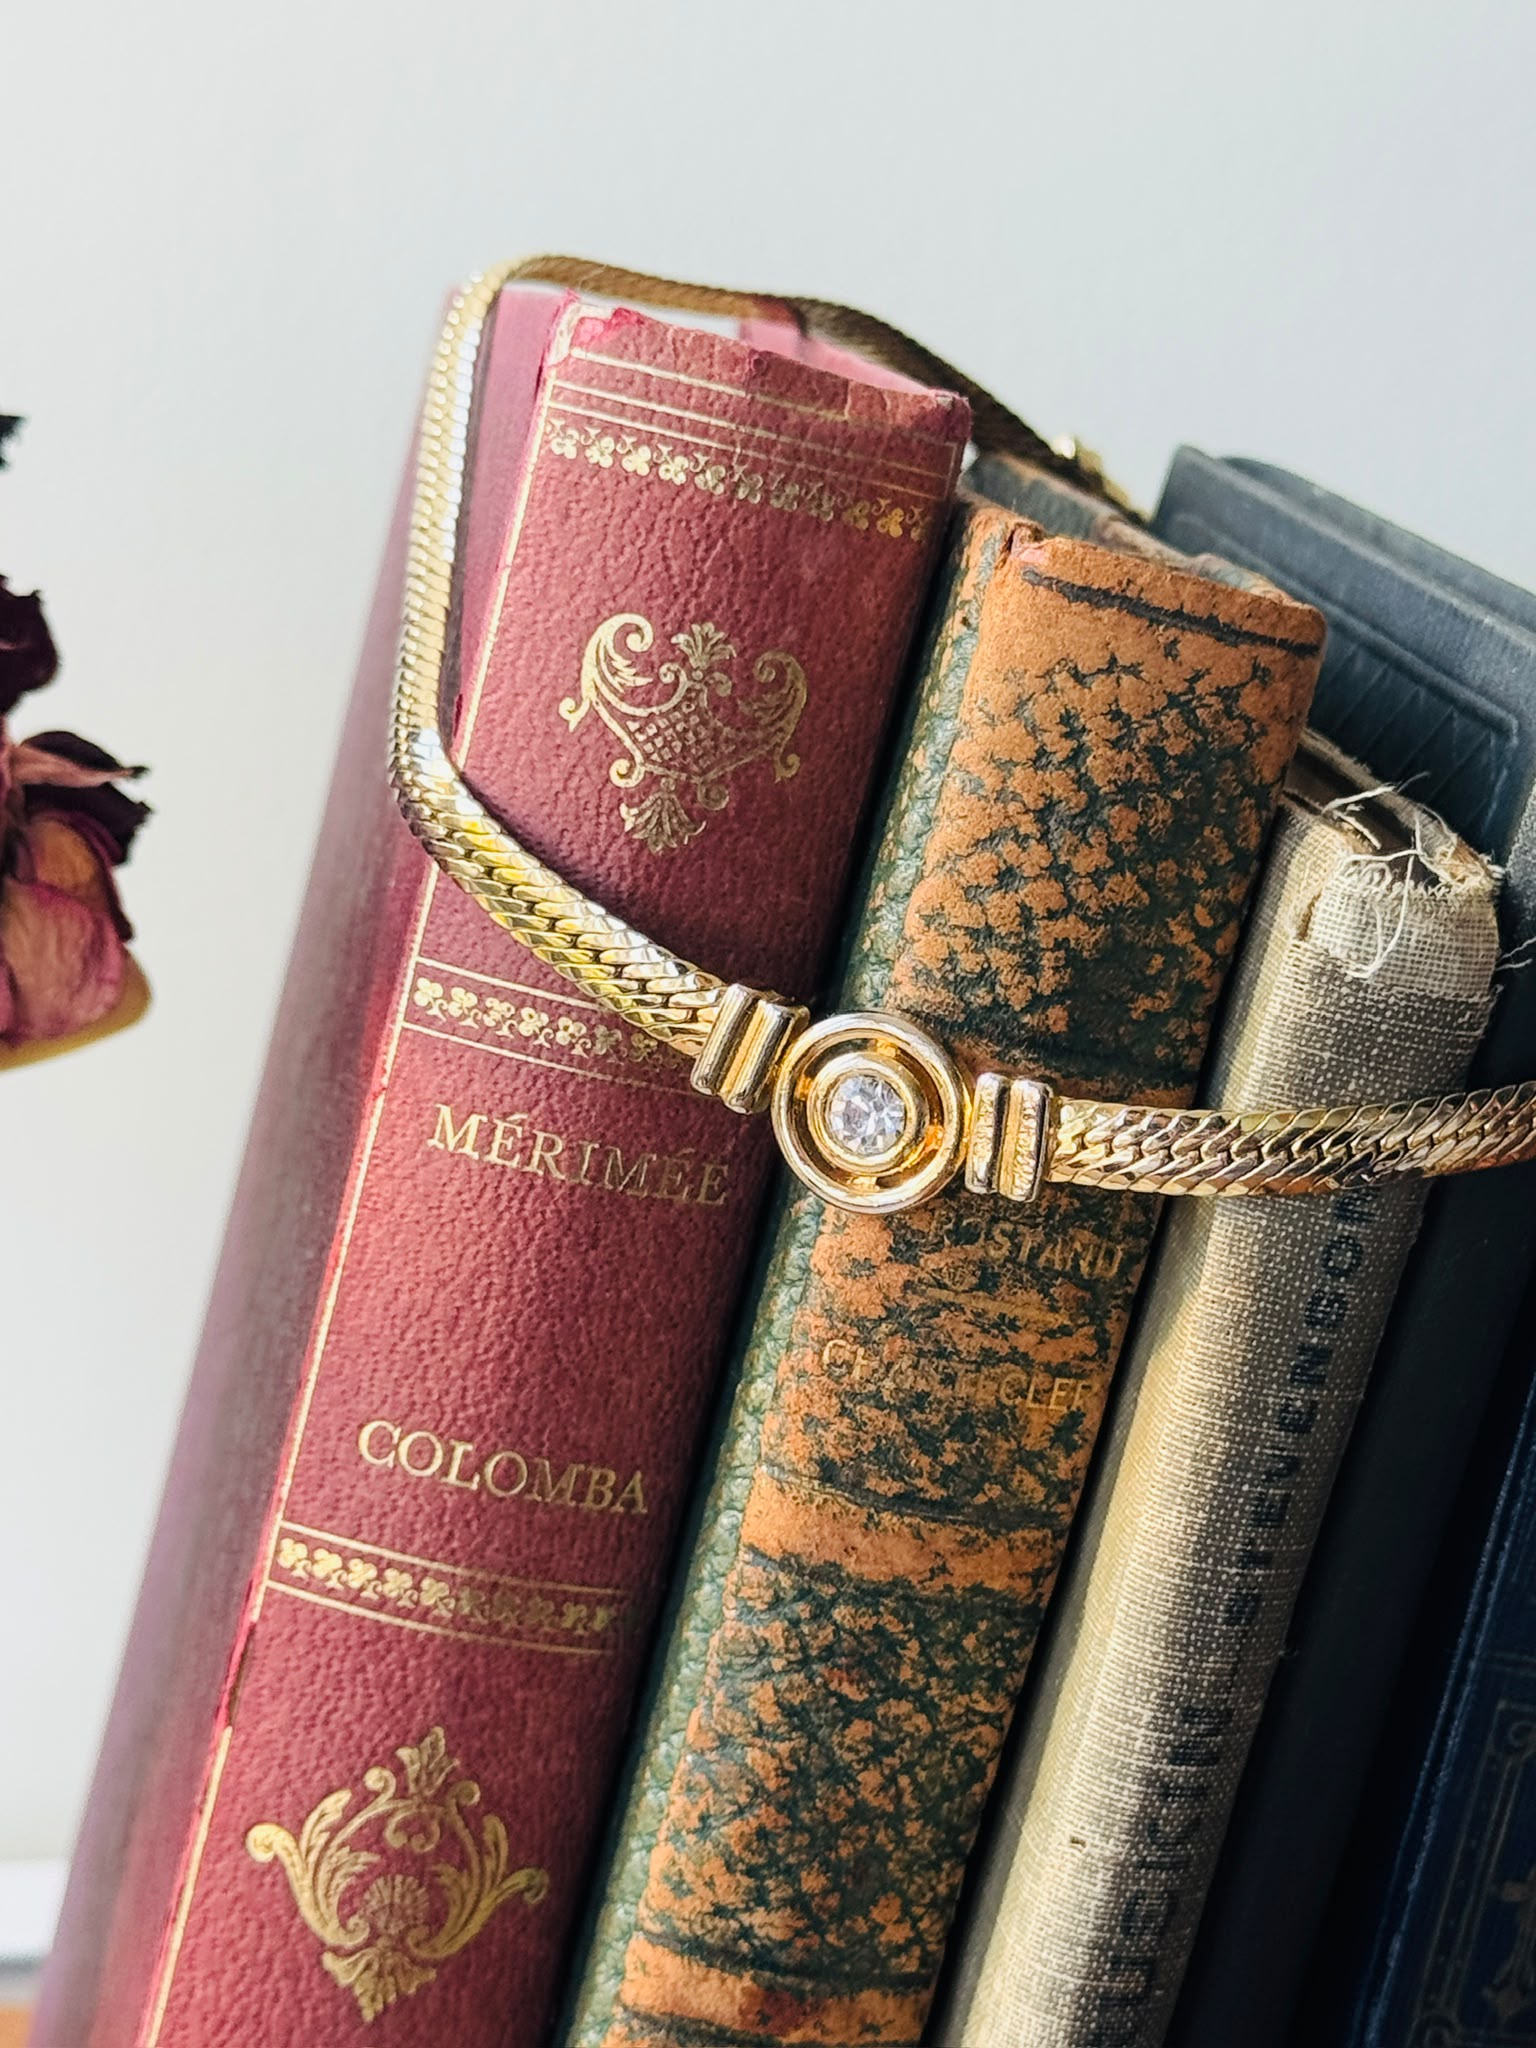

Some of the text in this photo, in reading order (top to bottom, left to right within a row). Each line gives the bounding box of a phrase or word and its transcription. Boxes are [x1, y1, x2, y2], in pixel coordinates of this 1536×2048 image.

[428, 1104, 730, 1206] MÉRIMÉE
[1220, 1187, 1382, 1627] STEVENSON
[358, 1420, 649, 1515] COLOMBA
